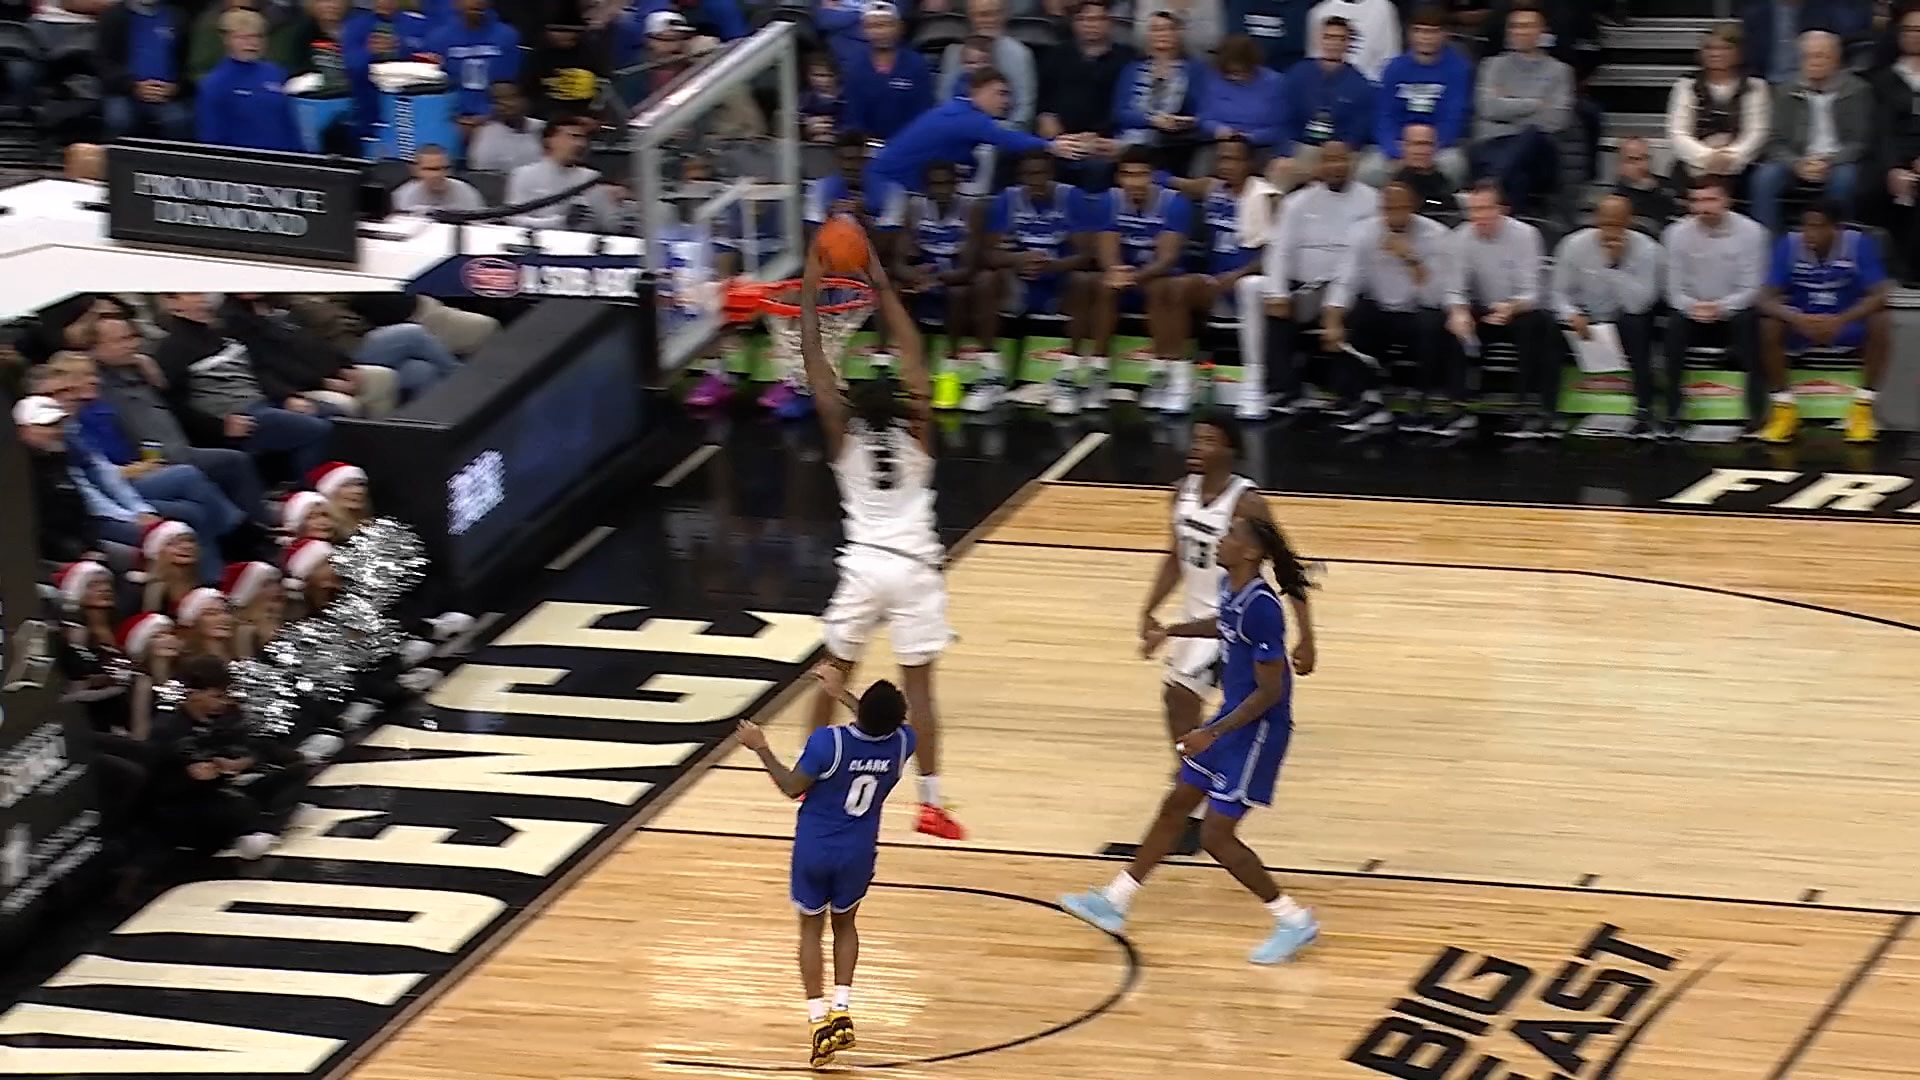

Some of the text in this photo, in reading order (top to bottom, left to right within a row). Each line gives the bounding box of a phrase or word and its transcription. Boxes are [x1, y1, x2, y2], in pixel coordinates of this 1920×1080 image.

[132, 171, 328, 214] PROVIDENCE
[153, 199, 309, 237] DIAMOND
[1659, 467, 1920, 513] FR
[847, 758, 891, 773] CLARK
[843, 774, 879, 817] 0
[1343, 945, 1535, 1080] BIG
